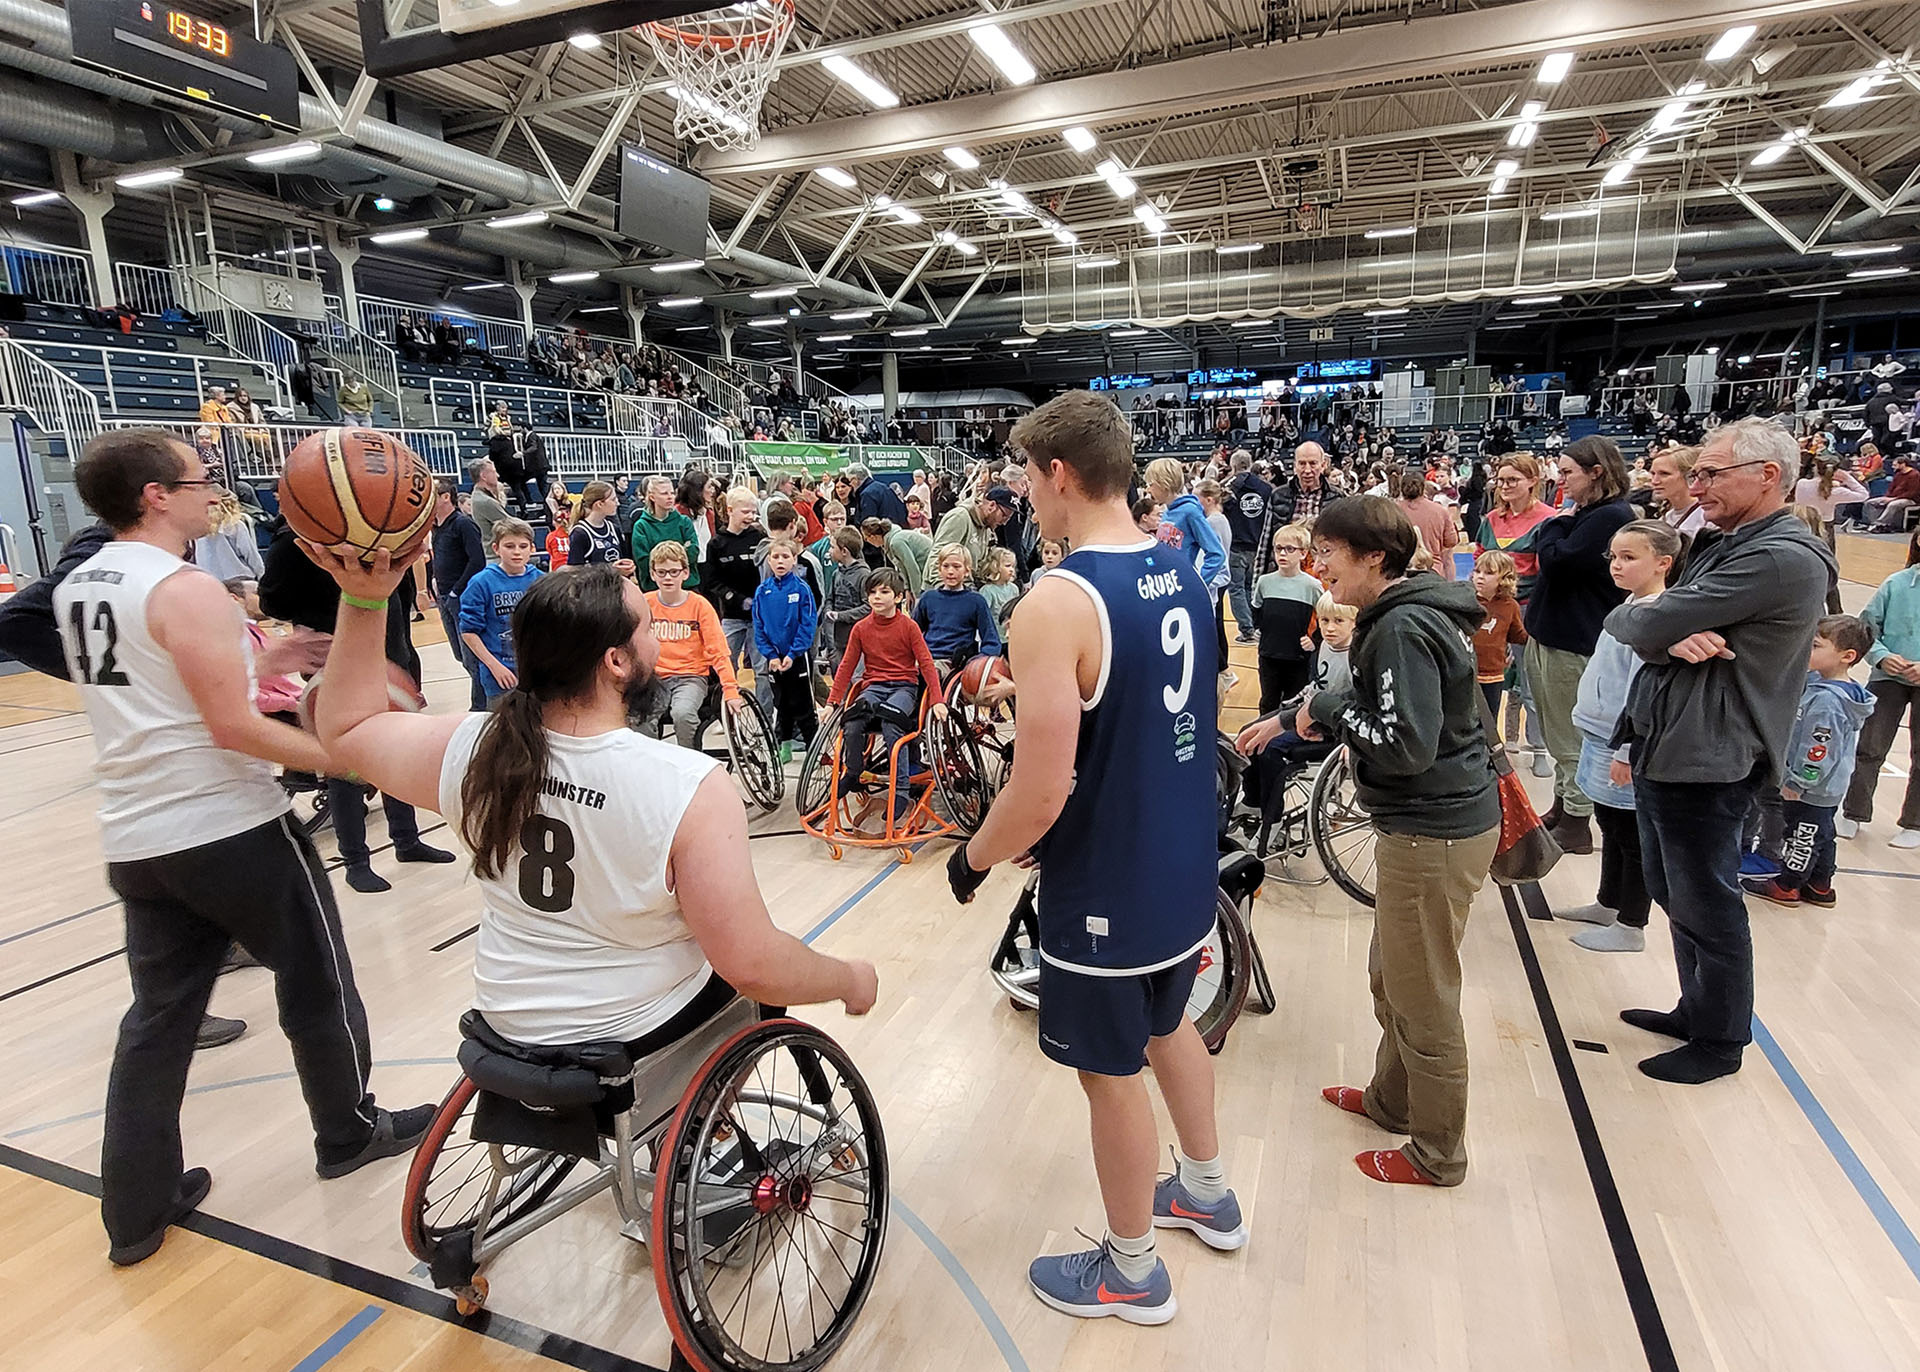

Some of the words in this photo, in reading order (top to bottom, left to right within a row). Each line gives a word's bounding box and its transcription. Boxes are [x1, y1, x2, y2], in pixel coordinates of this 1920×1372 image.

[167, 12, 229, 56] 19:33
[1316, 329, 1327, 339] H
[1136, 568, 1183, 601] GRUBE
[71, 600, 132, 687] 12
[1160, 606, 1195, 714] 9
[518, 813, 576, 914] 8
